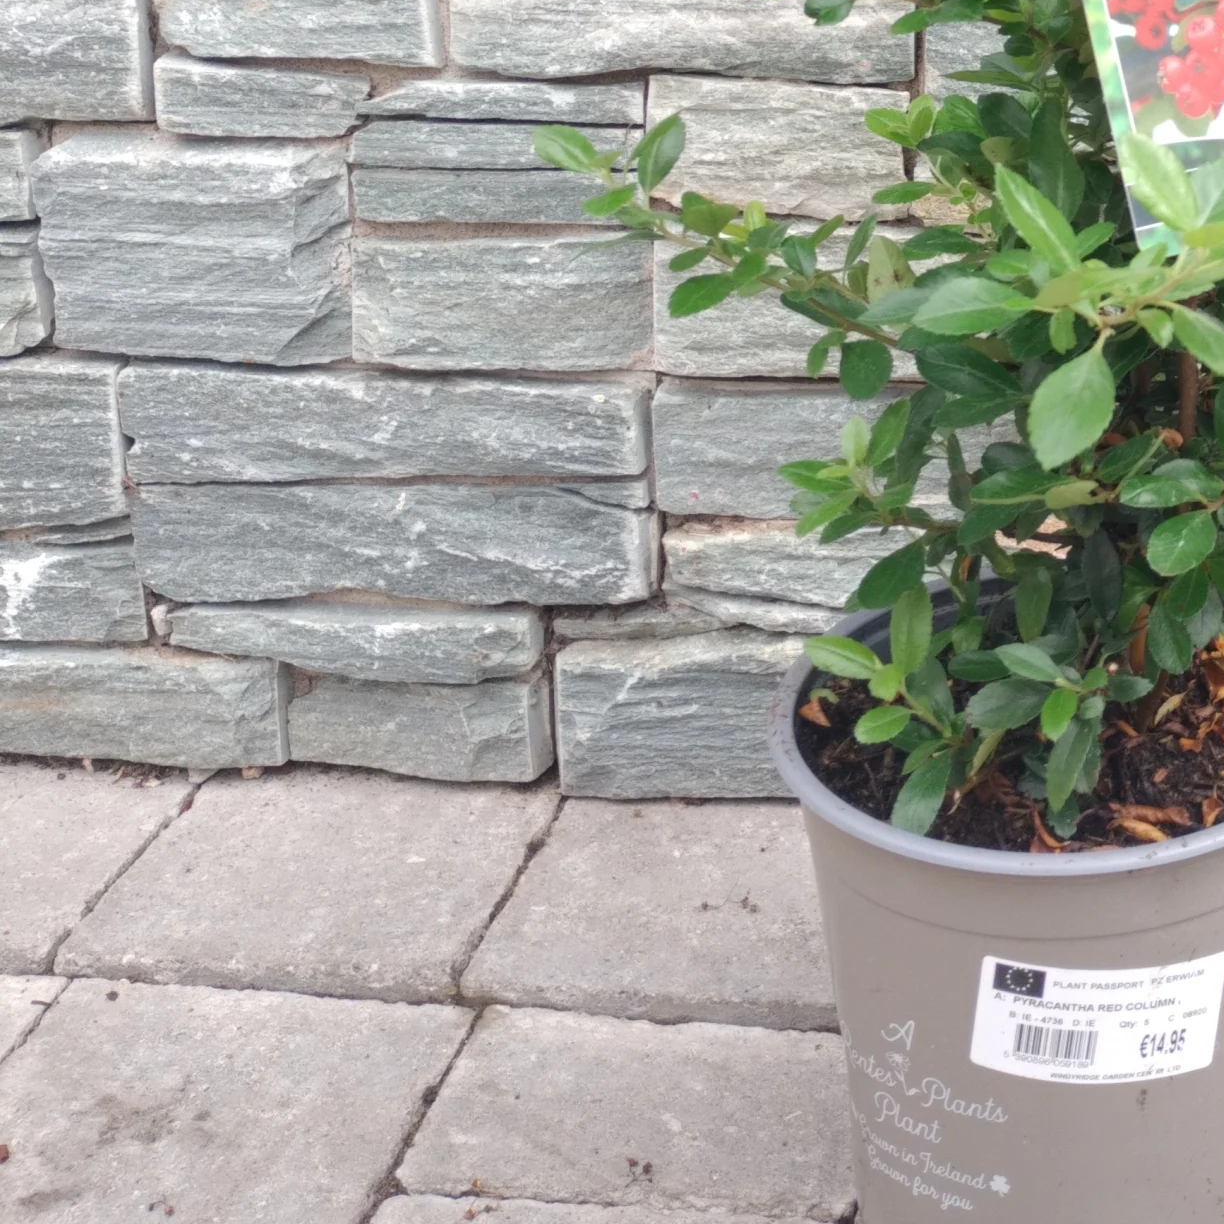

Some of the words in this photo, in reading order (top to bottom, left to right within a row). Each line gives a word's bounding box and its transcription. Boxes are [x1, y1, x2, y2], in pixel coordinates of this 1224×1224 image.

[1012, 994, 1095, 1013] PYRACANTHA
[1097, 1003, 1123, 1013] RED
[1125, 997, 1176, 1012] COLUMN
[1052, 980, 1087, 990] PLANT
[1090, 980, 1145, 990] PASSPORT
[1139, 1028, 1187, 1058] €14.95
[874, 1091, 942, 1144] Plant
[920, 1077, 1009, 1123] Plants
[866, 1144, 911, 1187] Grown
[912, 1175, 940, 1196] for
[940, 1189, 974, 1211] you
[901, 1147, 918, 1166] in
[919, 1151, 987, 1190] Ireland
